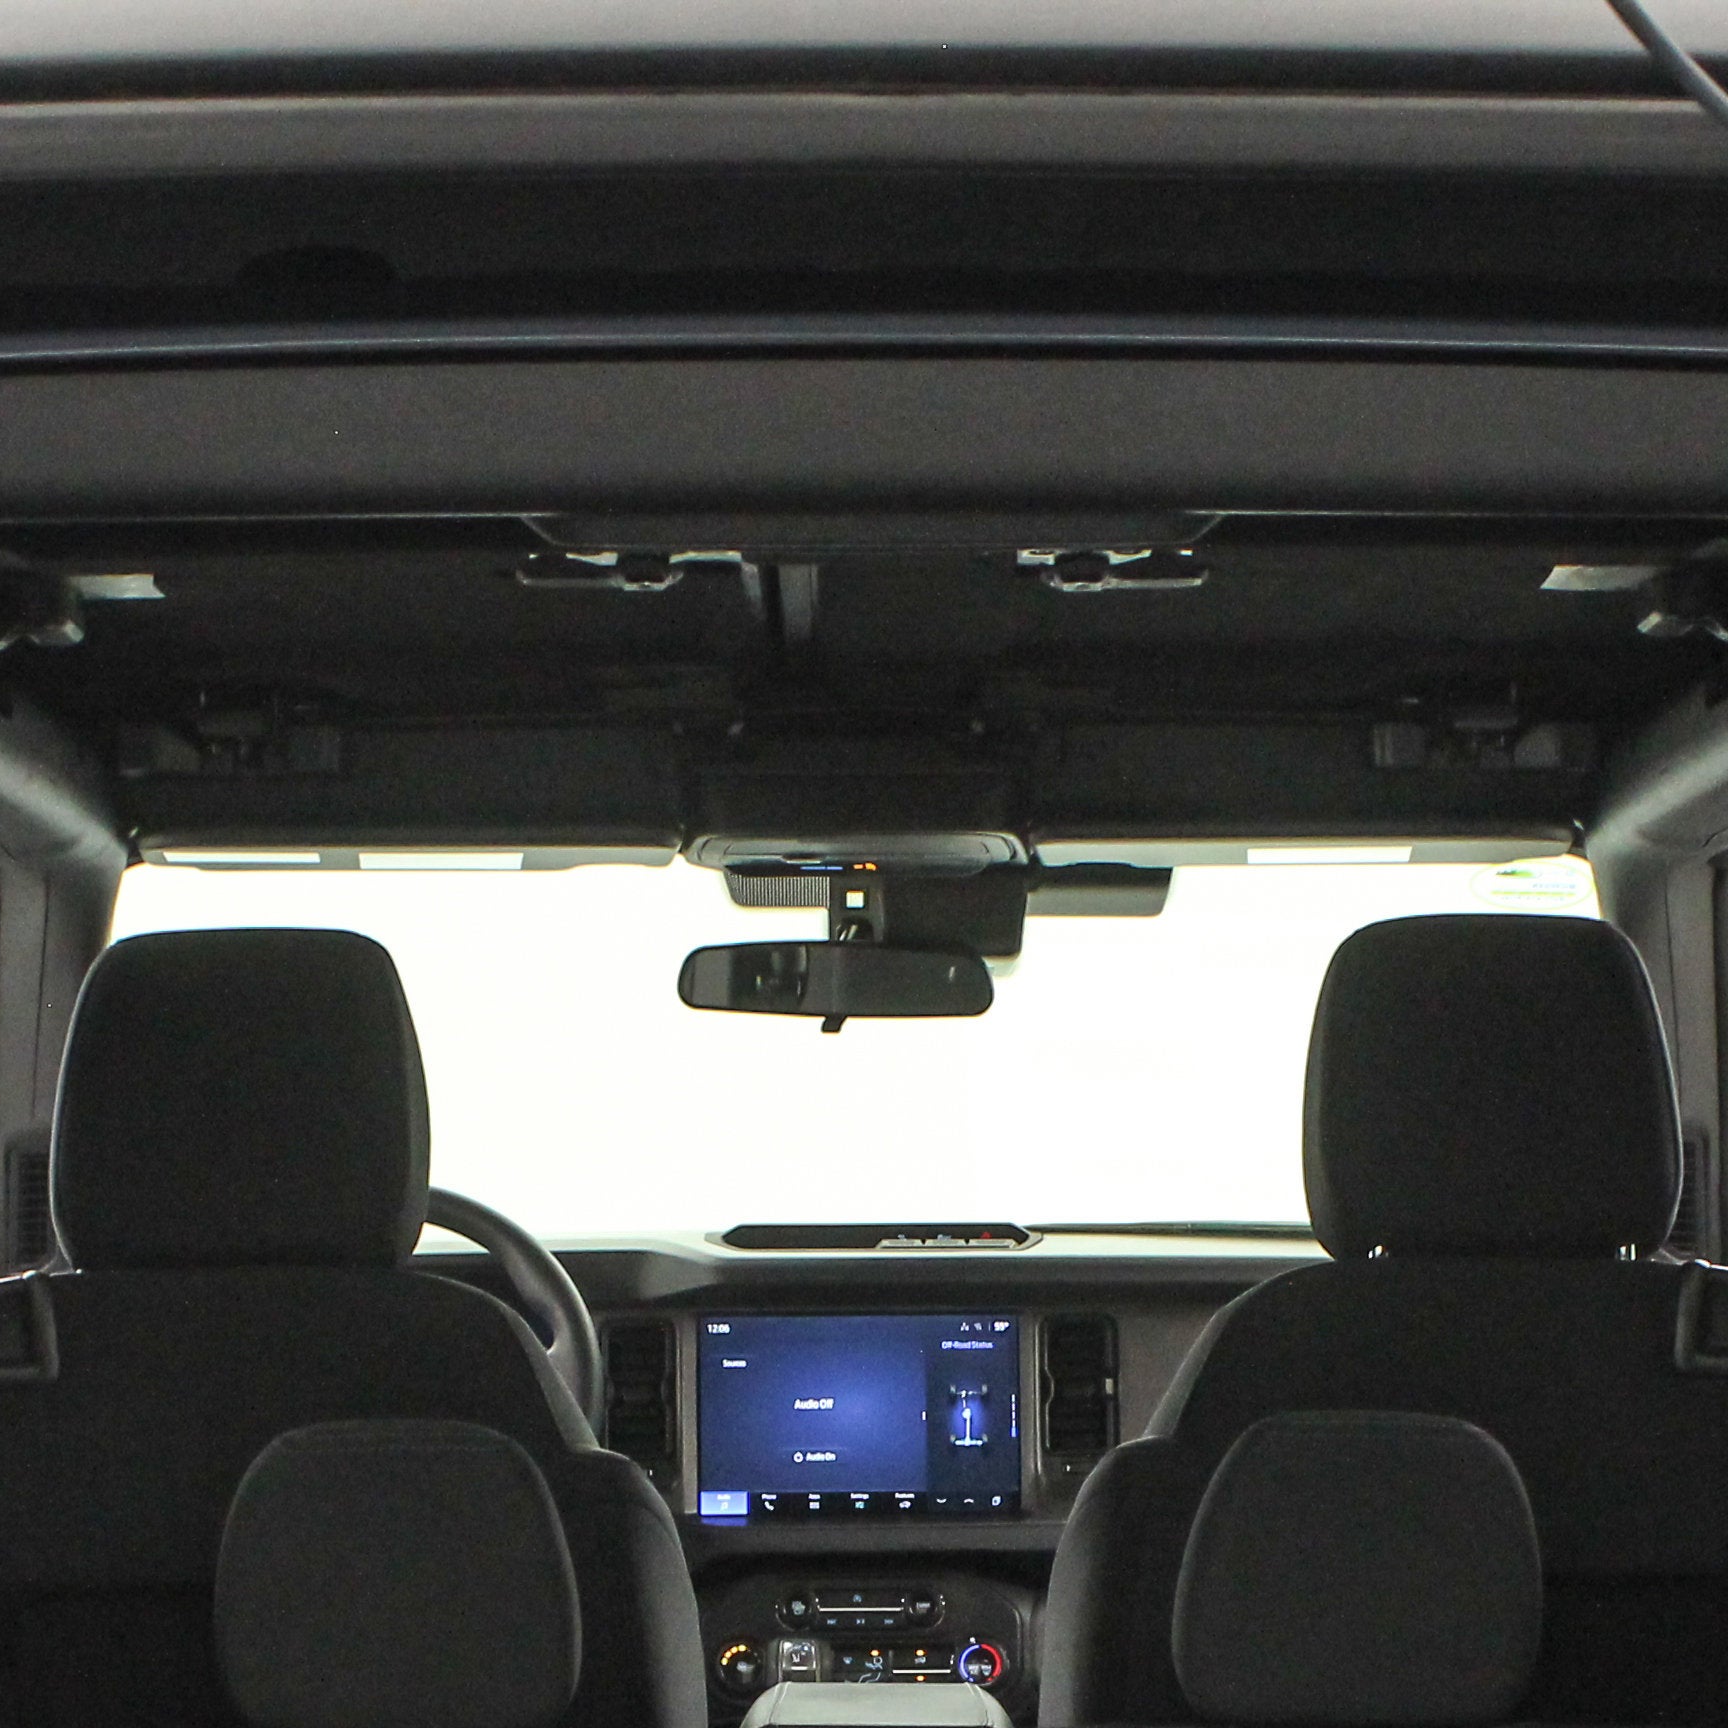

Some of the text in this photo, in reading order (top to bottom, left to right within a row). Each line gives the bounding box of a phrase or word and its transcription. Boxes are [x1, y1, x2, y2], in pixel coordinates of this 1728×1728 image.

[971, 1340, 994, 1349] Status
[794, 1398, 834, 1410] Audio Off
[805, 1452, 836, 1462] Audio On
